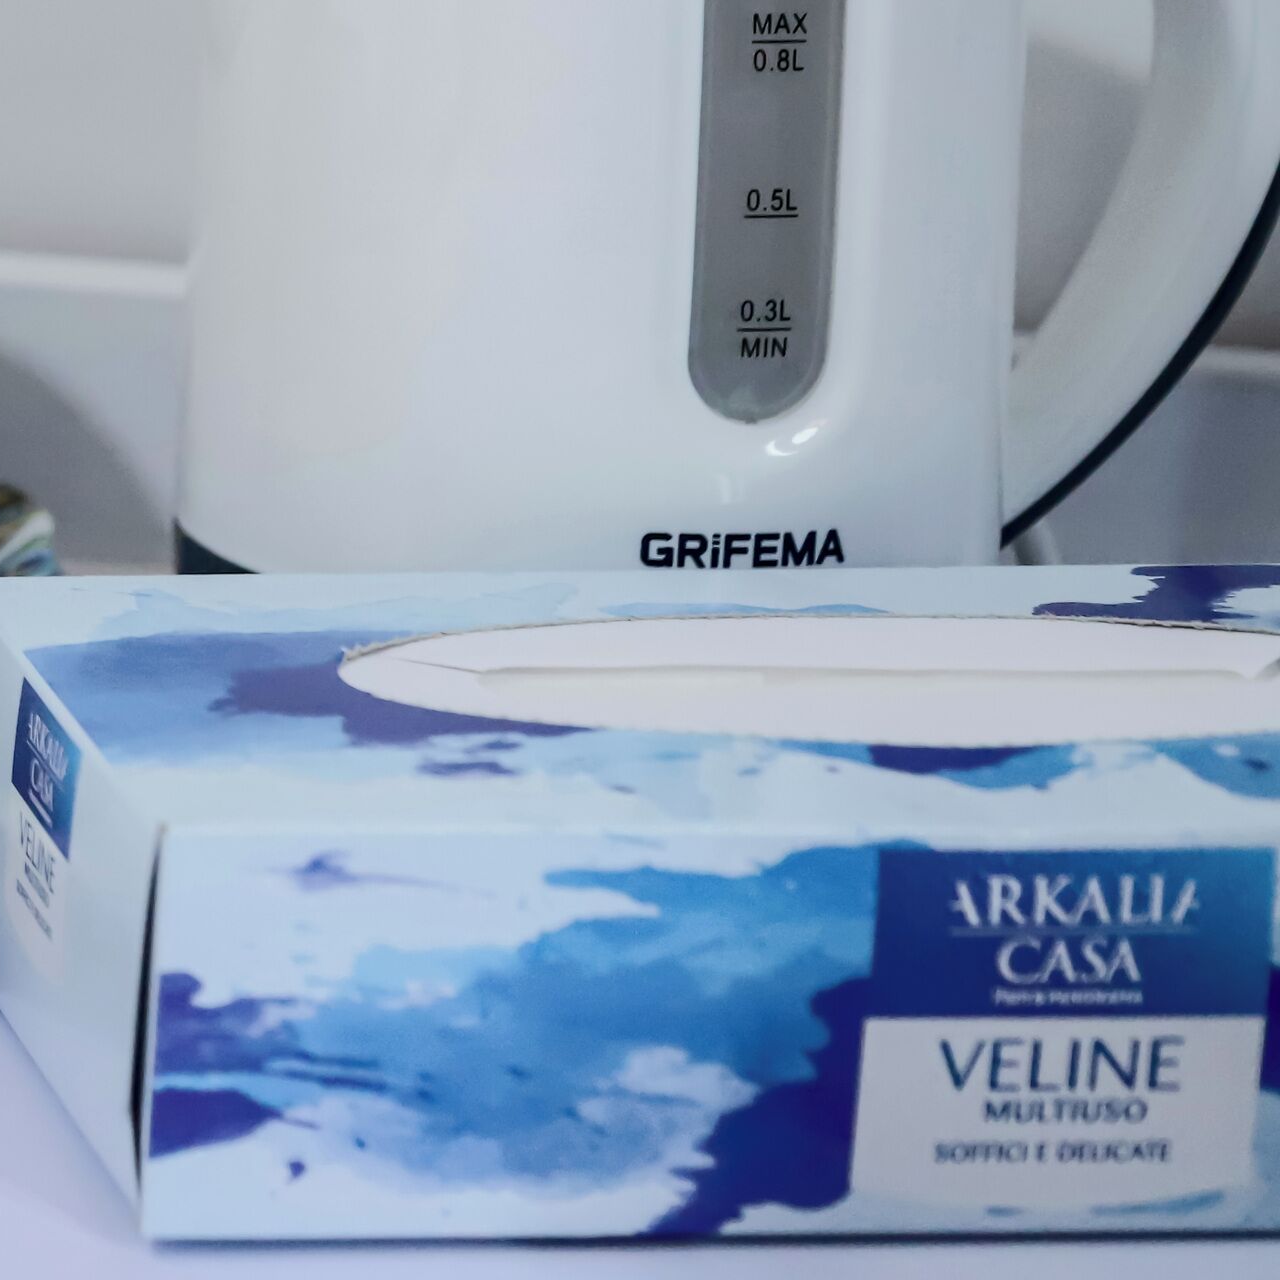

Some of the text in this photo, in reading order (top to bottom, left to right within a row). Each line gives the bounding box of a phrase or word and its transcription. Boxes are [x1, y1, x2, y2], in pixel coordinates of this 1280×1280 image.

[752, 13, 808, 35] MAX
[753, 48, 805, 72] 0.8L
[746, 189, 798, 211] 0.5L
[740, 299, 791, 322] 0.3L
[740, 337, 788, 358] MIN
[948, 872, 1201, 928] ARKALIA
[994, 933, 1143, 986] CASA
[939, 1035, 1186, 1092] VELINE
[984, 1097, 1148, 1124] MULTIUSO
[1055, 1138, 1173, 1164] DELICATE
